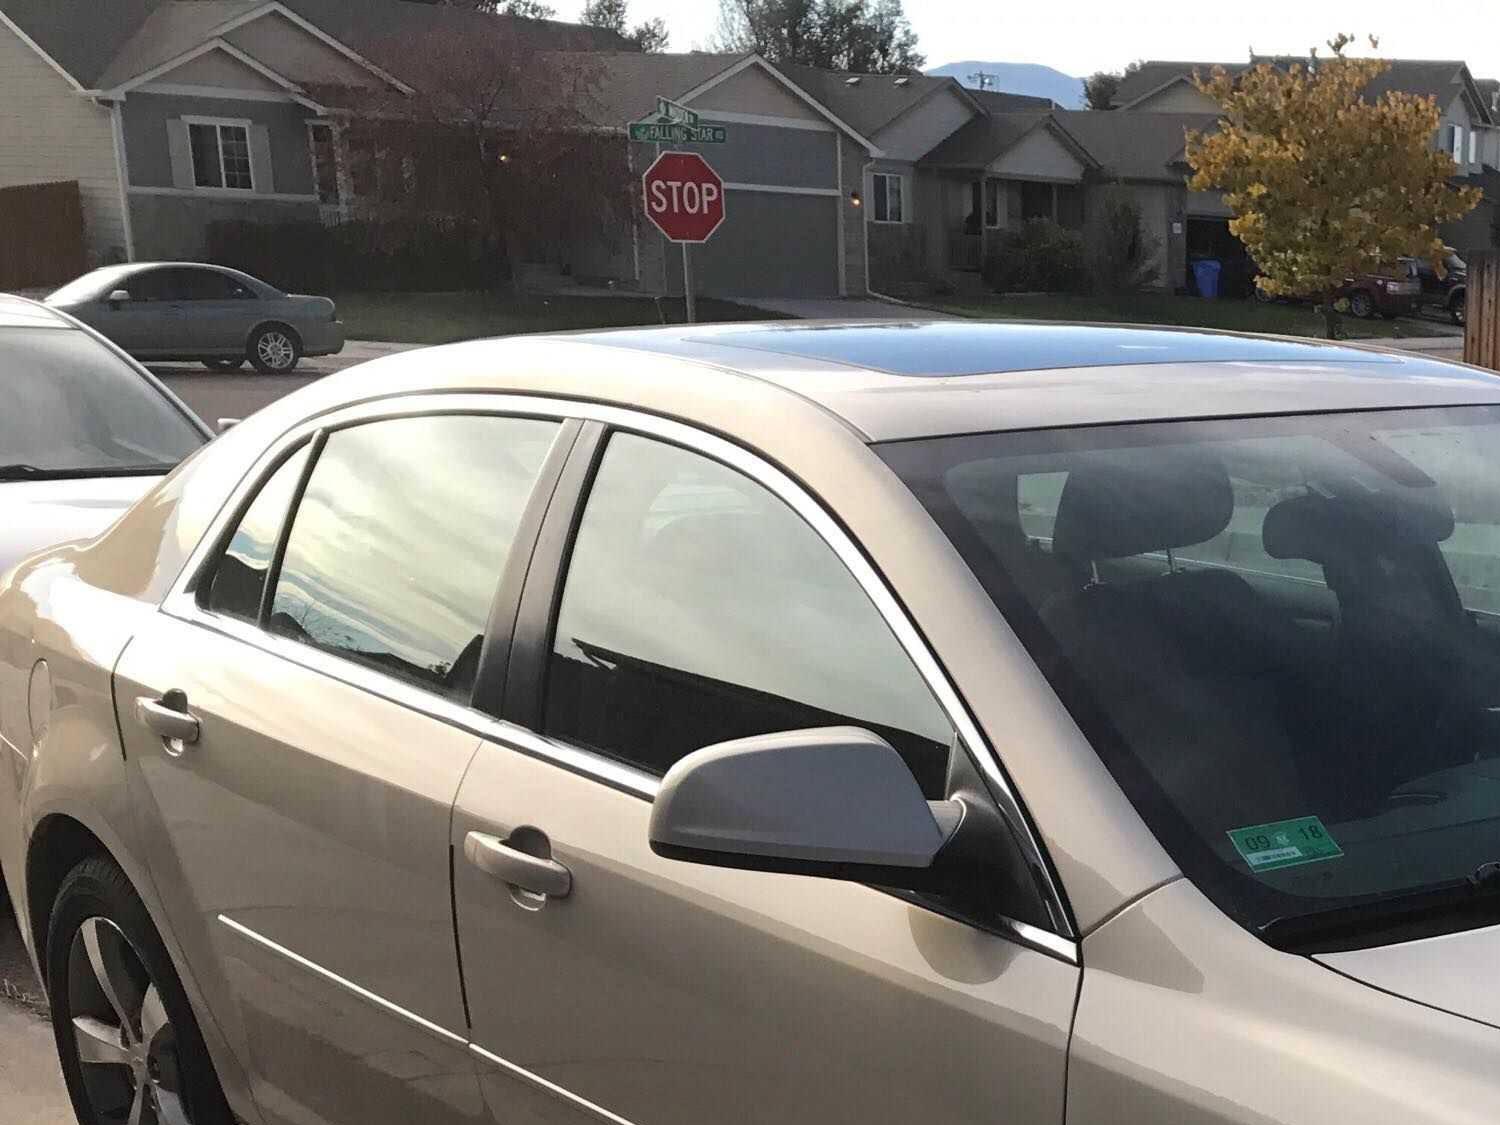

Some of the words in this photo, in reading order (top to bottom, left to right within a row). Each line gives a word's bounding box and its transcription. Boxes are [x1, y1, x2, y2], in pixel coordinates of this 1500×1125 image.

[650, 126, 688, 141] FALLING
[691, 128, 713, 142] STAR
[651, 180, 718, 214] STOP
[1244, 834, 1271, 850] 09
[1298, 824, 1323, 840] 18
